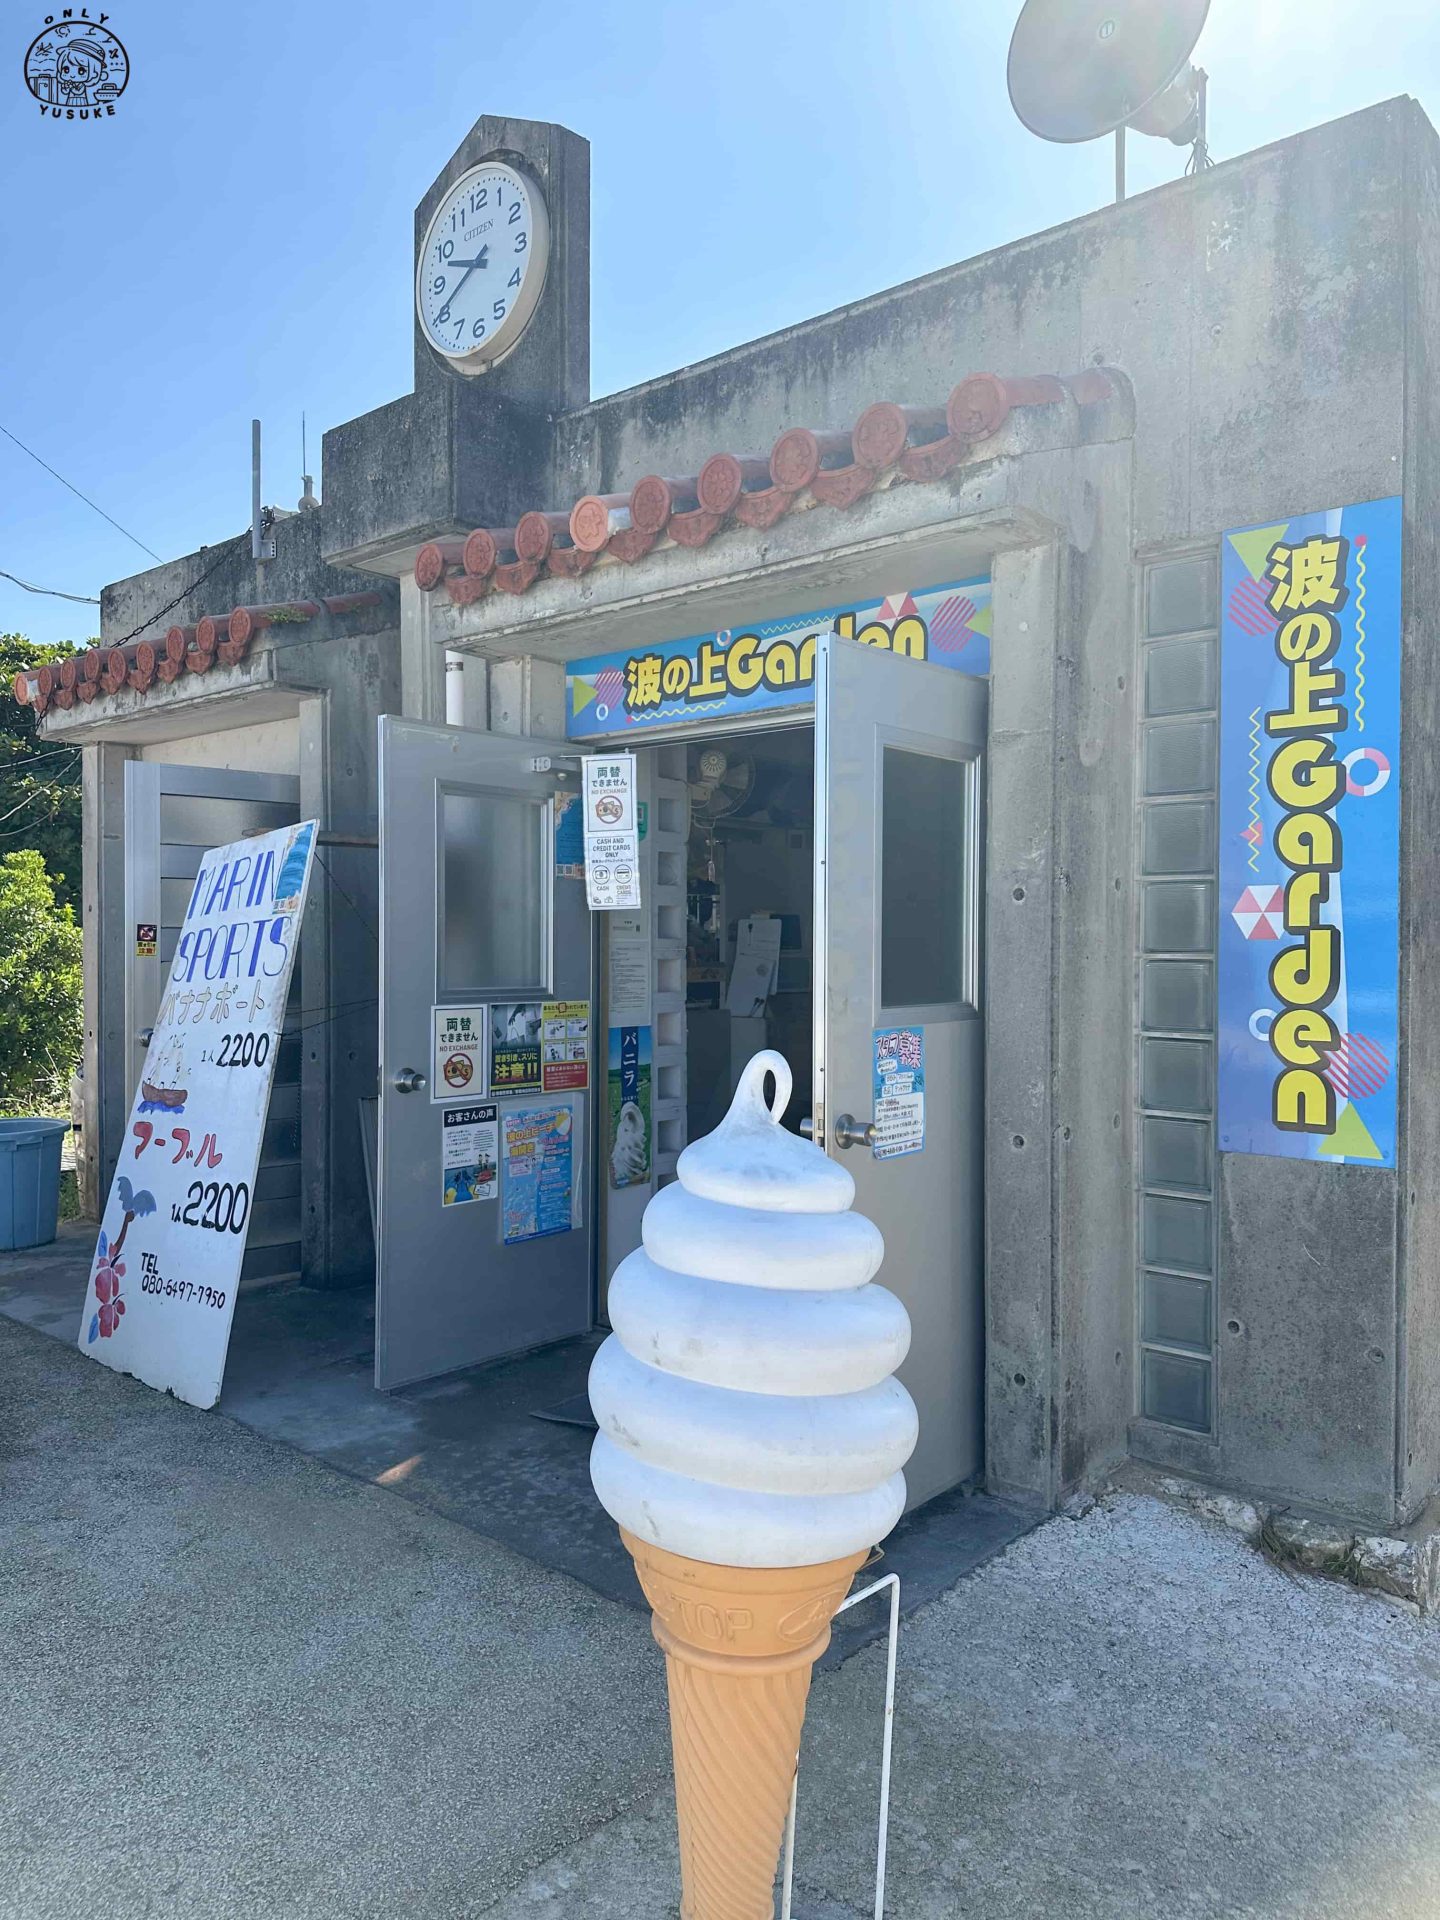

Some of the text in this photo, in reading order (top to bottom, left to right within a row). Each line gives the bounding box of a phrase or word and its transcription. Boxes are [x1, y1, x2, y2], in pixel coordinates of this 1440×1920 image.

[470, 188, 488, 213] 12
[452, 208, 466, 232] 11
[508, 202, 521, 225] 2
[463, 218, 494, 242] CITIZEN
[437, 239, 454, 263] 10
[514, 231, 527, 253] 3
[434, 275, 446, 296] 9
[507, 267, 522, 288] 4
[439, 302, 451, 324] 8
[493, 299, 506, 320] 5
[453, 318, 466, 340] 7
[472, 318, 486, 339] 6
[624, 612, 928, 710] 波の上Garn
[591, 779, 628, 788] できません
[597, 766, 621, 779] 両替
[1265, 535, 1345, 1131] 波の上Garden
[187, 848, 285, 920] MARIN
[172, 916, 294, 983] SPORTS
[156, 980, 265, 1026] バナナボート
[446, 1017, 472, 1032] 両替
[439, 1032, 479, 1043] できません
[439, 1043, 479, 1053] NO EXCHANGE
[216, 1031, 270, 1068] 2200
[623, 1031, 638, 1087] バニラ
[447, 1107, 494, 1124] お客さんの声
[183, 1180, 249, 1235] 2200
[141, 1252, 159, 1275] TEL
[142, 1274, 226, 1310] 080-6497-7950
[670, 1593, 753, 1641] TOP
